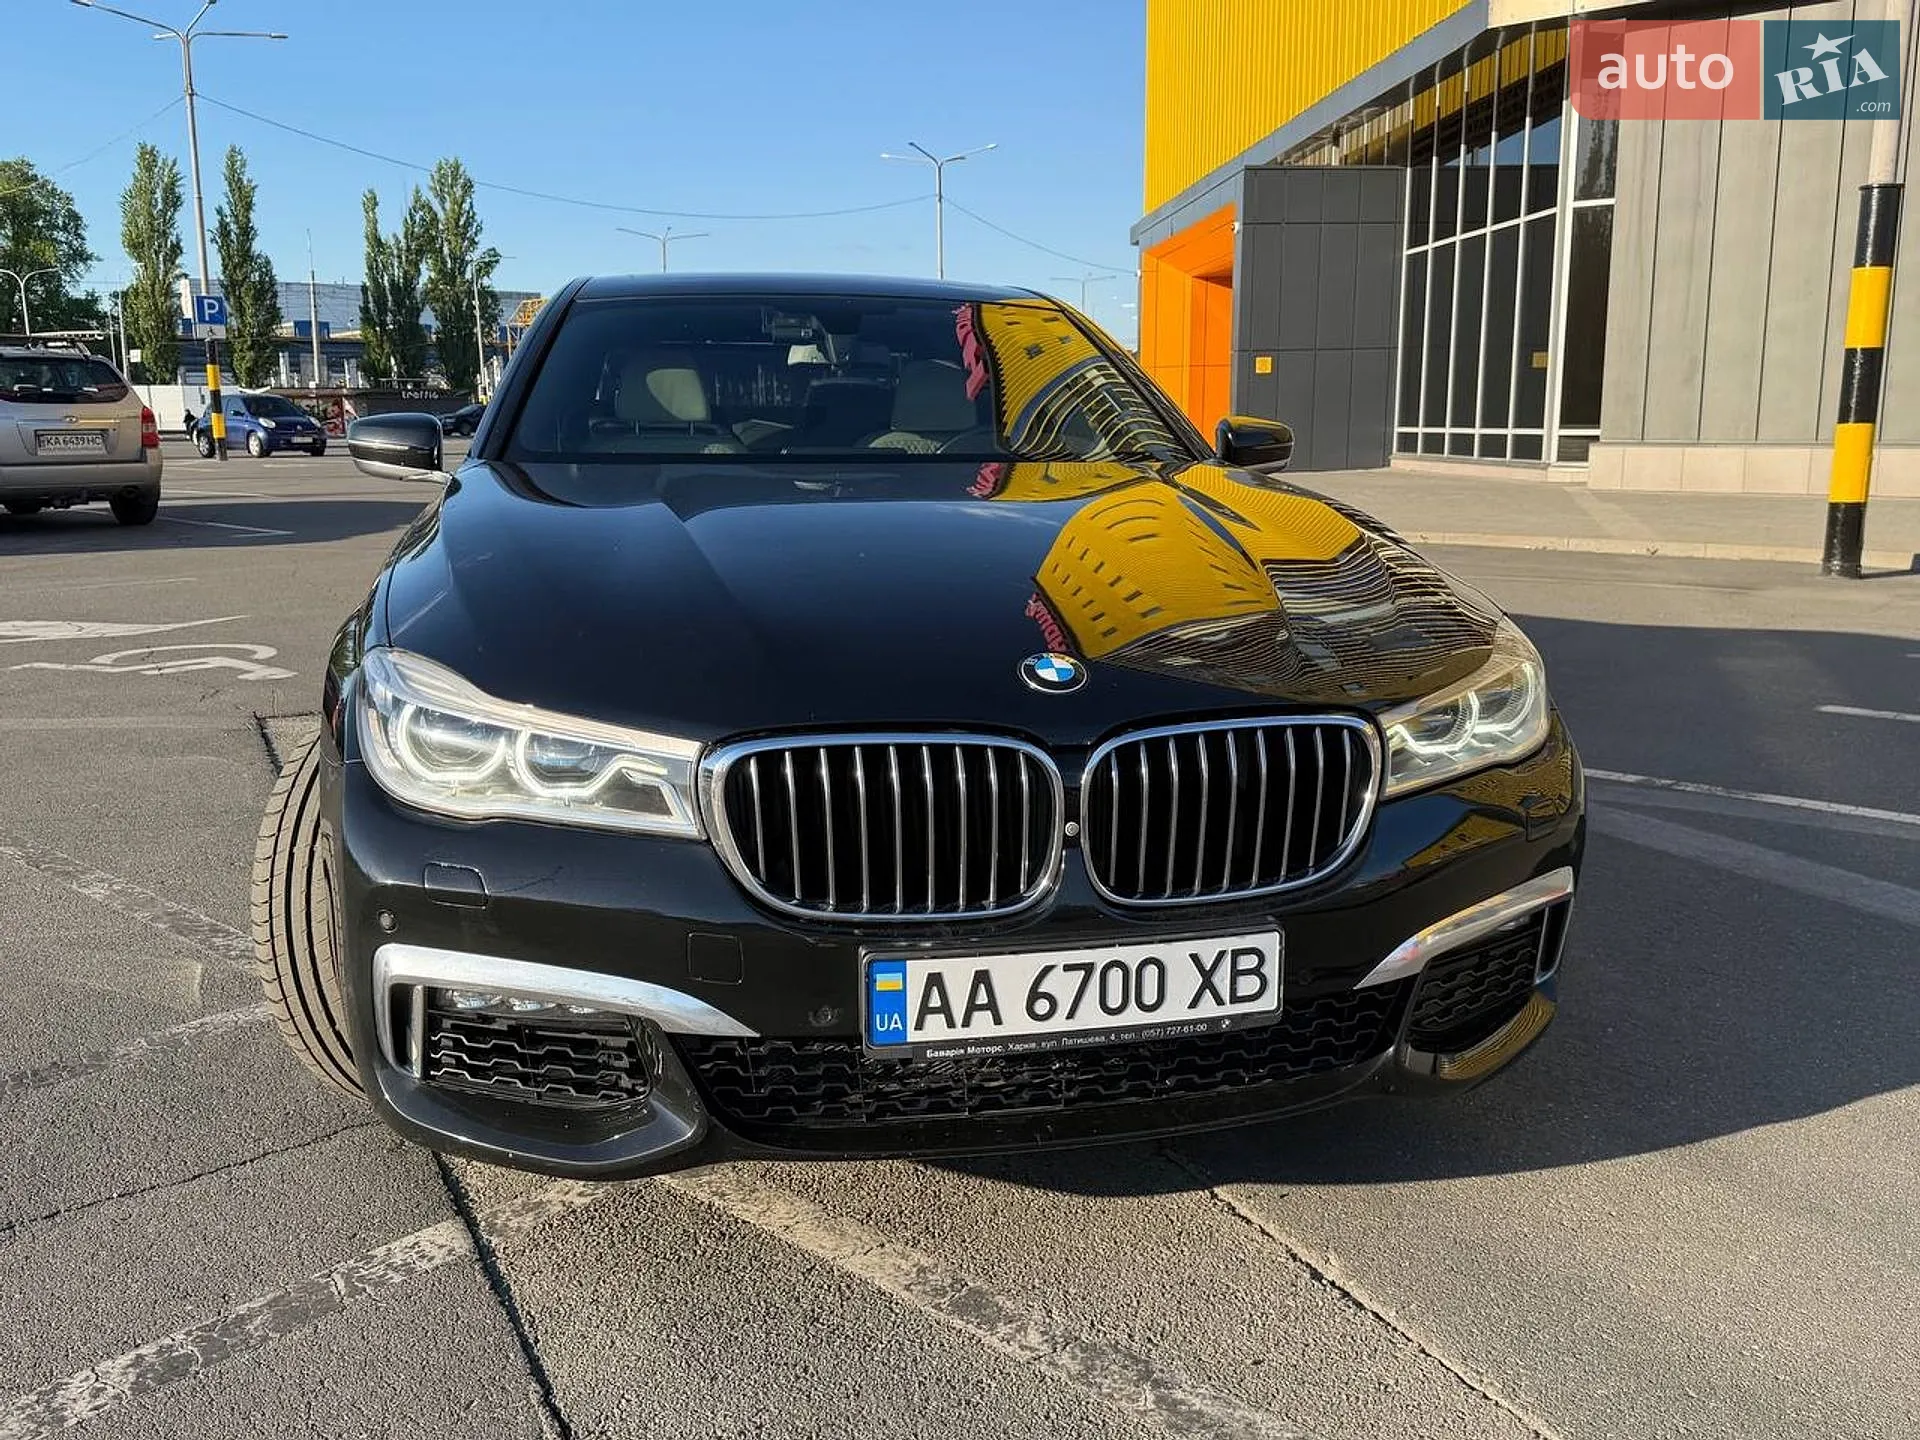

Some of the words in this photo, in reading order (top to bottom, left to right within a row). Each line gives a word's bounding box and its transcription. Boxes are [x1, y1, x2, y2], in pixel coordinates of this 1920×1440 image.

[203, 298, 219, 321] P
[913, 971, 1003, 1032] AA
[1025, 957, 1165, 1022] 6700
[1187, 947, 1268, 1010] XB
[875, 1015, 903, 1032] UA
